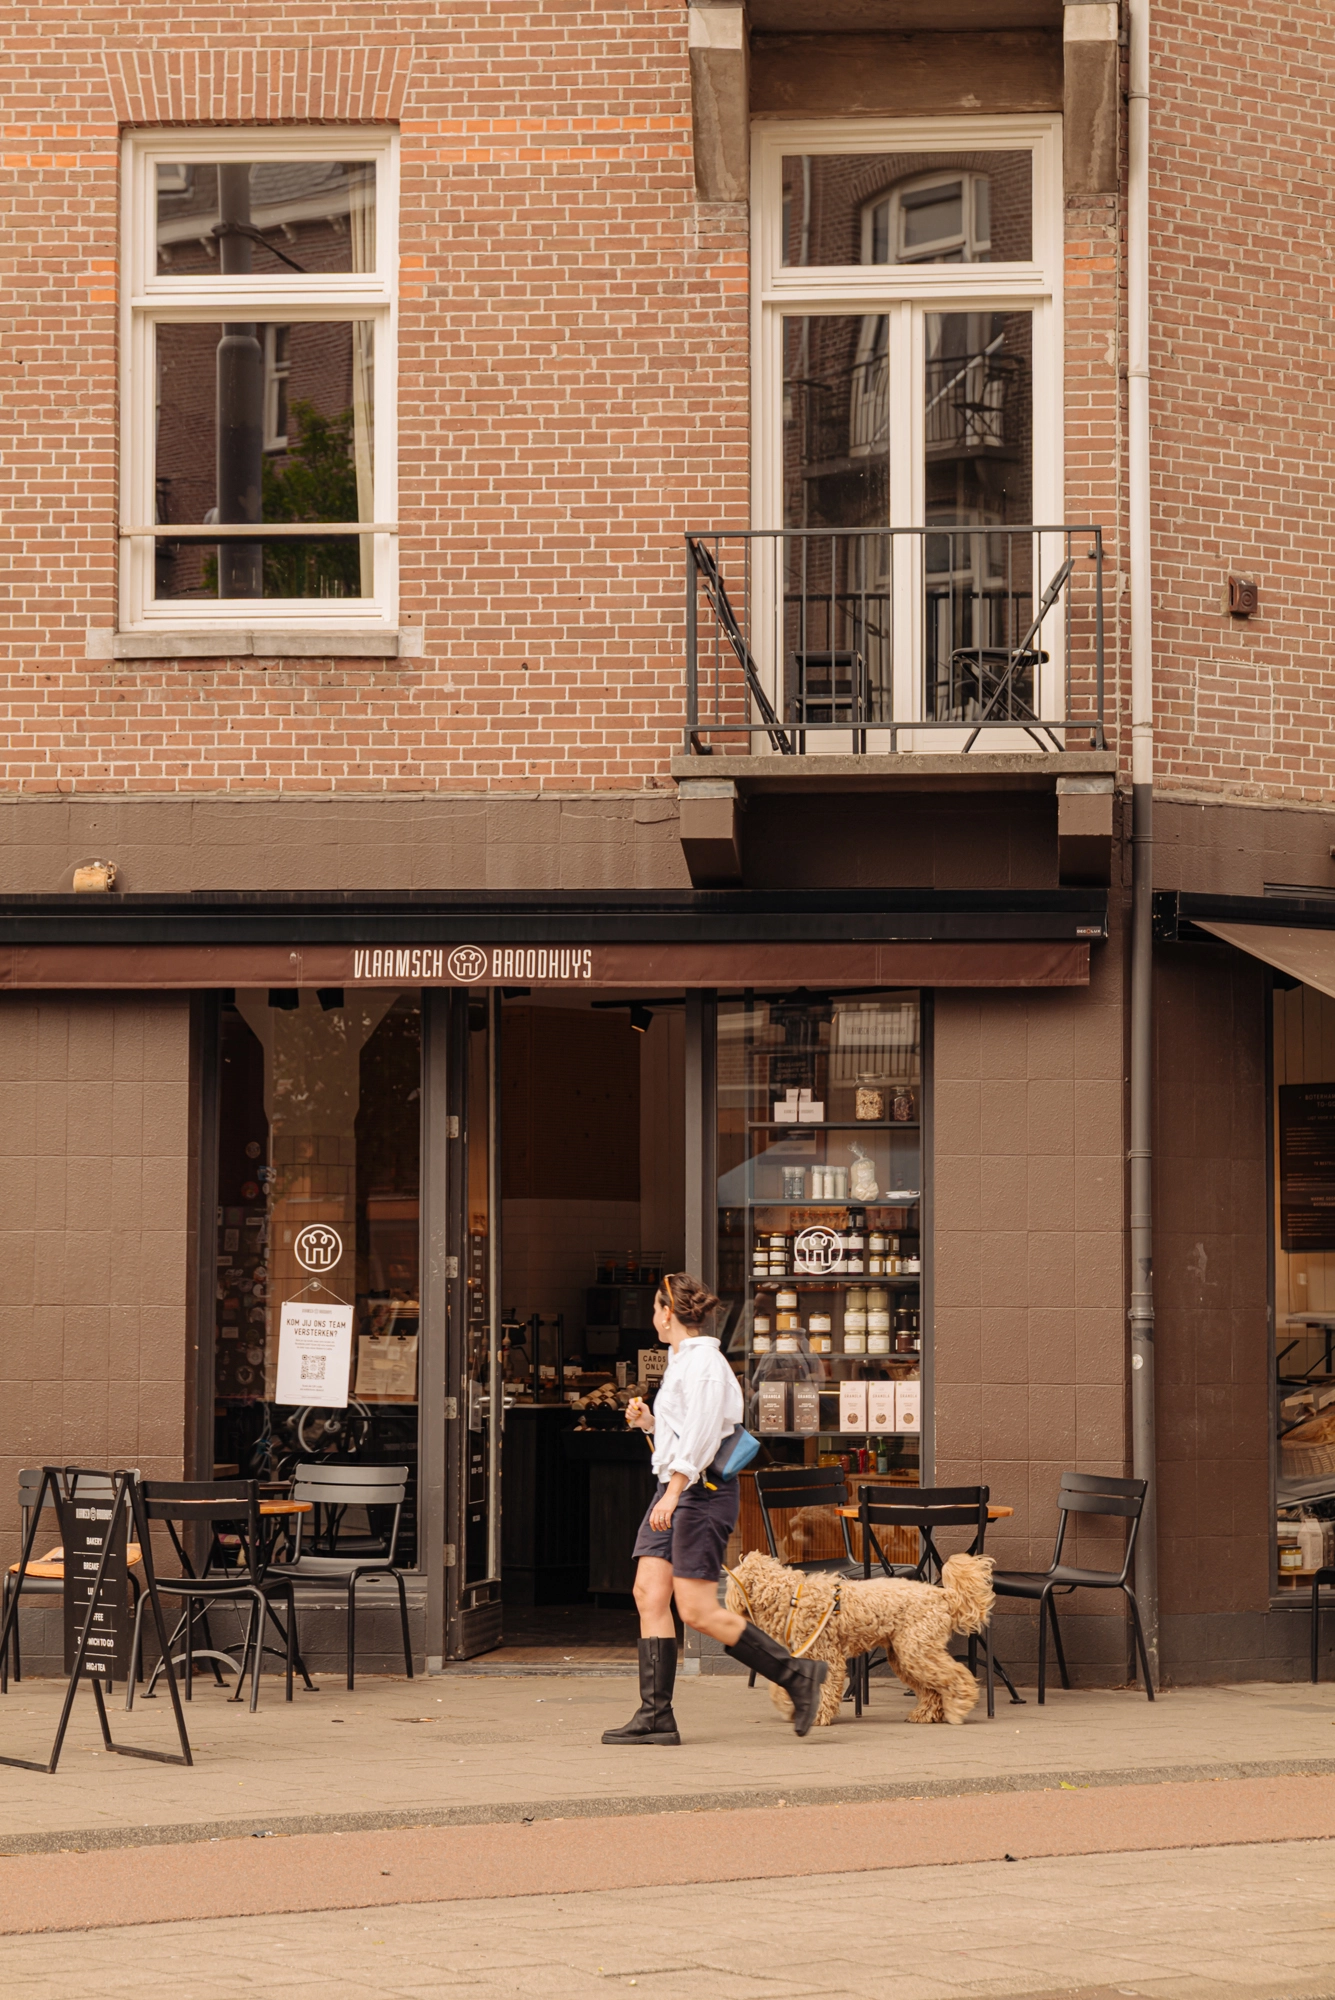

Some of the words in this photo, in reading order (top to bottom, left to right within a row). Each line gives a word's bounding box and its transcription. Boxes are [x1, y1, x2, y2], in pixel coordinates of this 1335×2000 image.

[354, 949, 443, 978] VLAAMSCH
[493, 949, 592, 979] BROODHUYS
[286, 1318, 300, 1326] KOM
[302, 1319, 312, 1327] JIJ
[313, 1320, 327, 1328] ONS
[329, 1321, 346, 1329] TEAM
[294, 1328, 338, 1337] VERSTERKEN?
[86, 1536, 103, 1546] BAKERY
[83, 1561, 100, 1571] BREAKF
[100, 1638, 107, 1647] TO
[106, 1639, 114, 1648] GO
[97, 1663, 106, 1672] TEA
